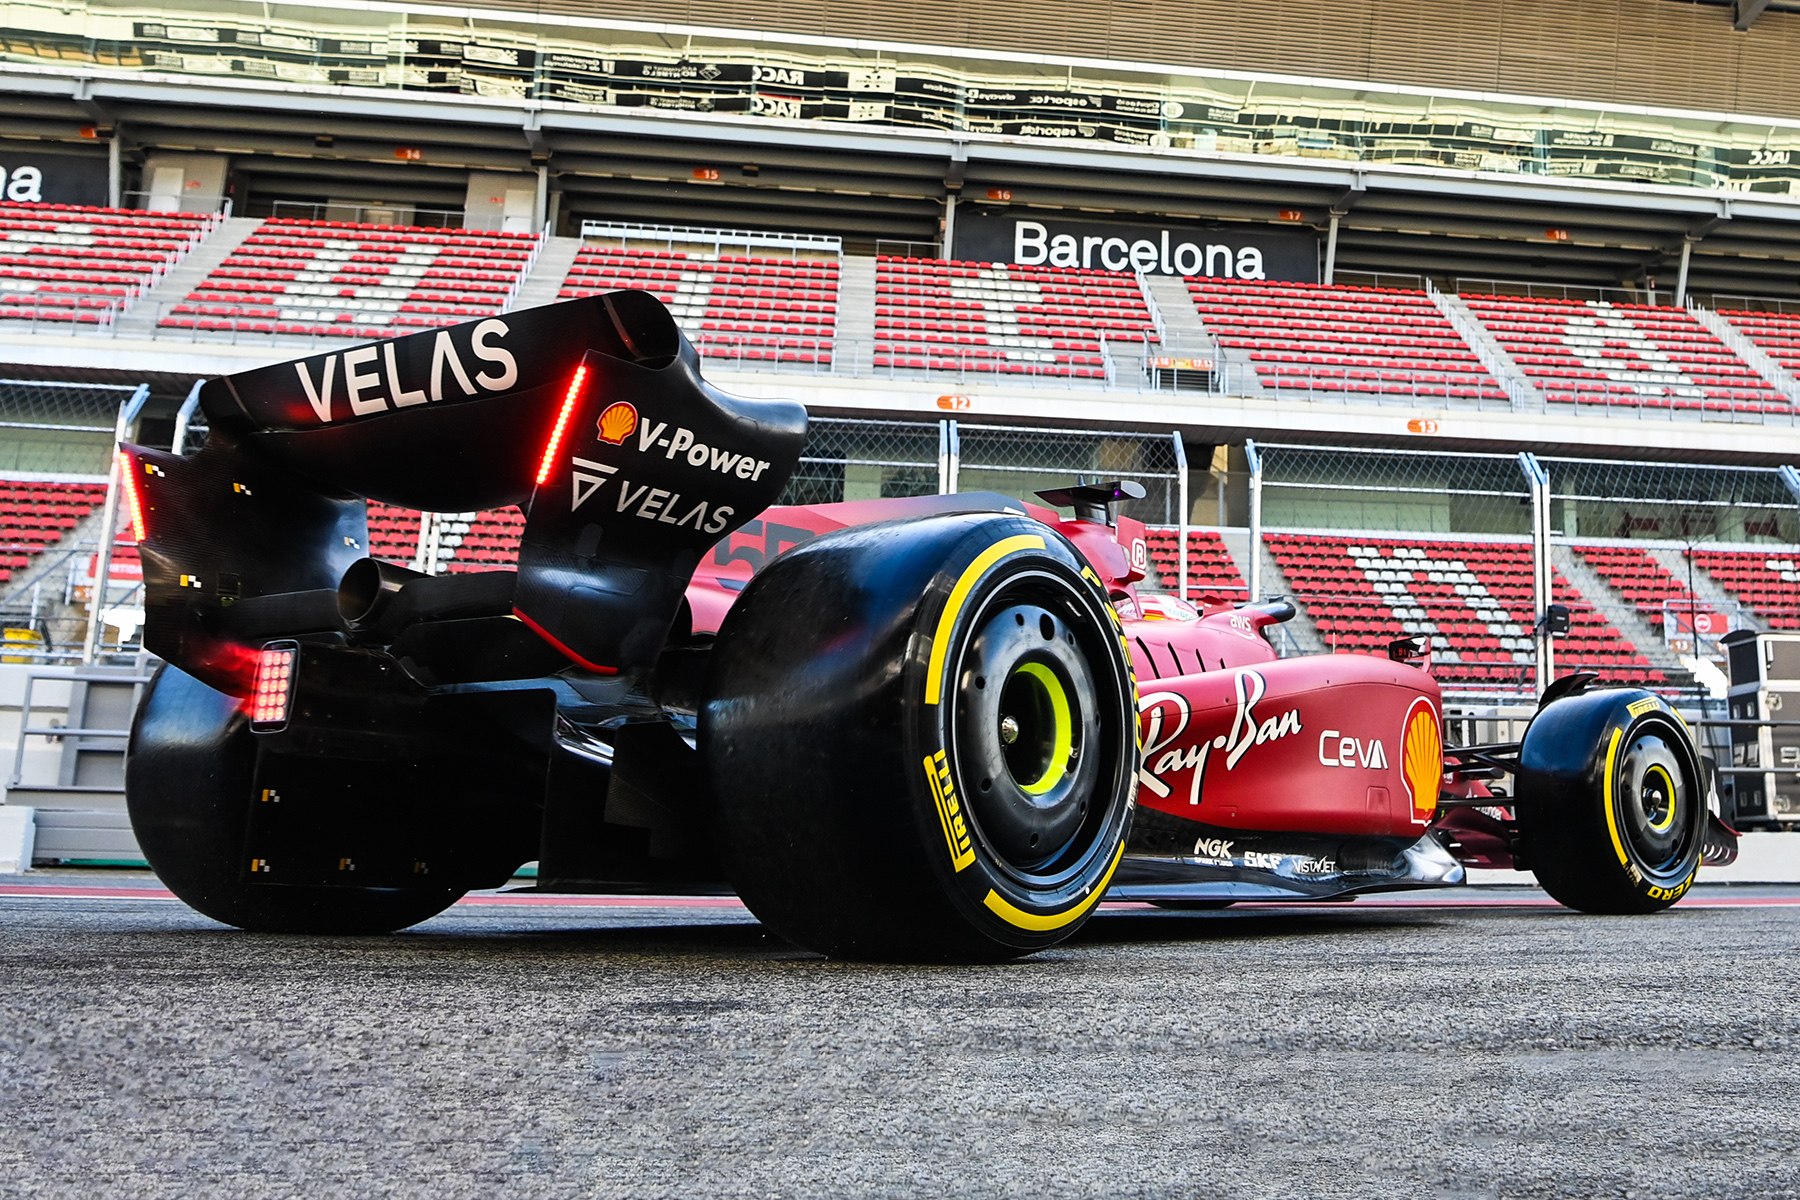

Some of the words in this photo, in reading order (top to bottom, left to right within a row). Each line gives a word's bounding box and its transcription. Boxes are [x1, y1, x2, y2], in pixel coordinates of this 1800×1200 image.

[406, 149, 421, 160] 14
[703, 169, 719, 180] 15
[997, 190, 1011, 201] 16
[1288, 211, 1301, 221] 17
[1013, 220, 1265, 281] Barcelona
[295, 318, 519, 422] VELAS
[949, 396, 969, 411] 12
[1418, 420, 1436, 434] 13
[636, 417, 771, 482] V-Power
[616, 481, 734, 534] VELAS
[1229, 614, 1252, 632] aws
[923, 748, 976, 873] PIRELLI
[1194, 838, 1234, 859] NGK
[1244, 851, 1283, 869] SKF
[1647, 872, 1694, 901] ZERO
